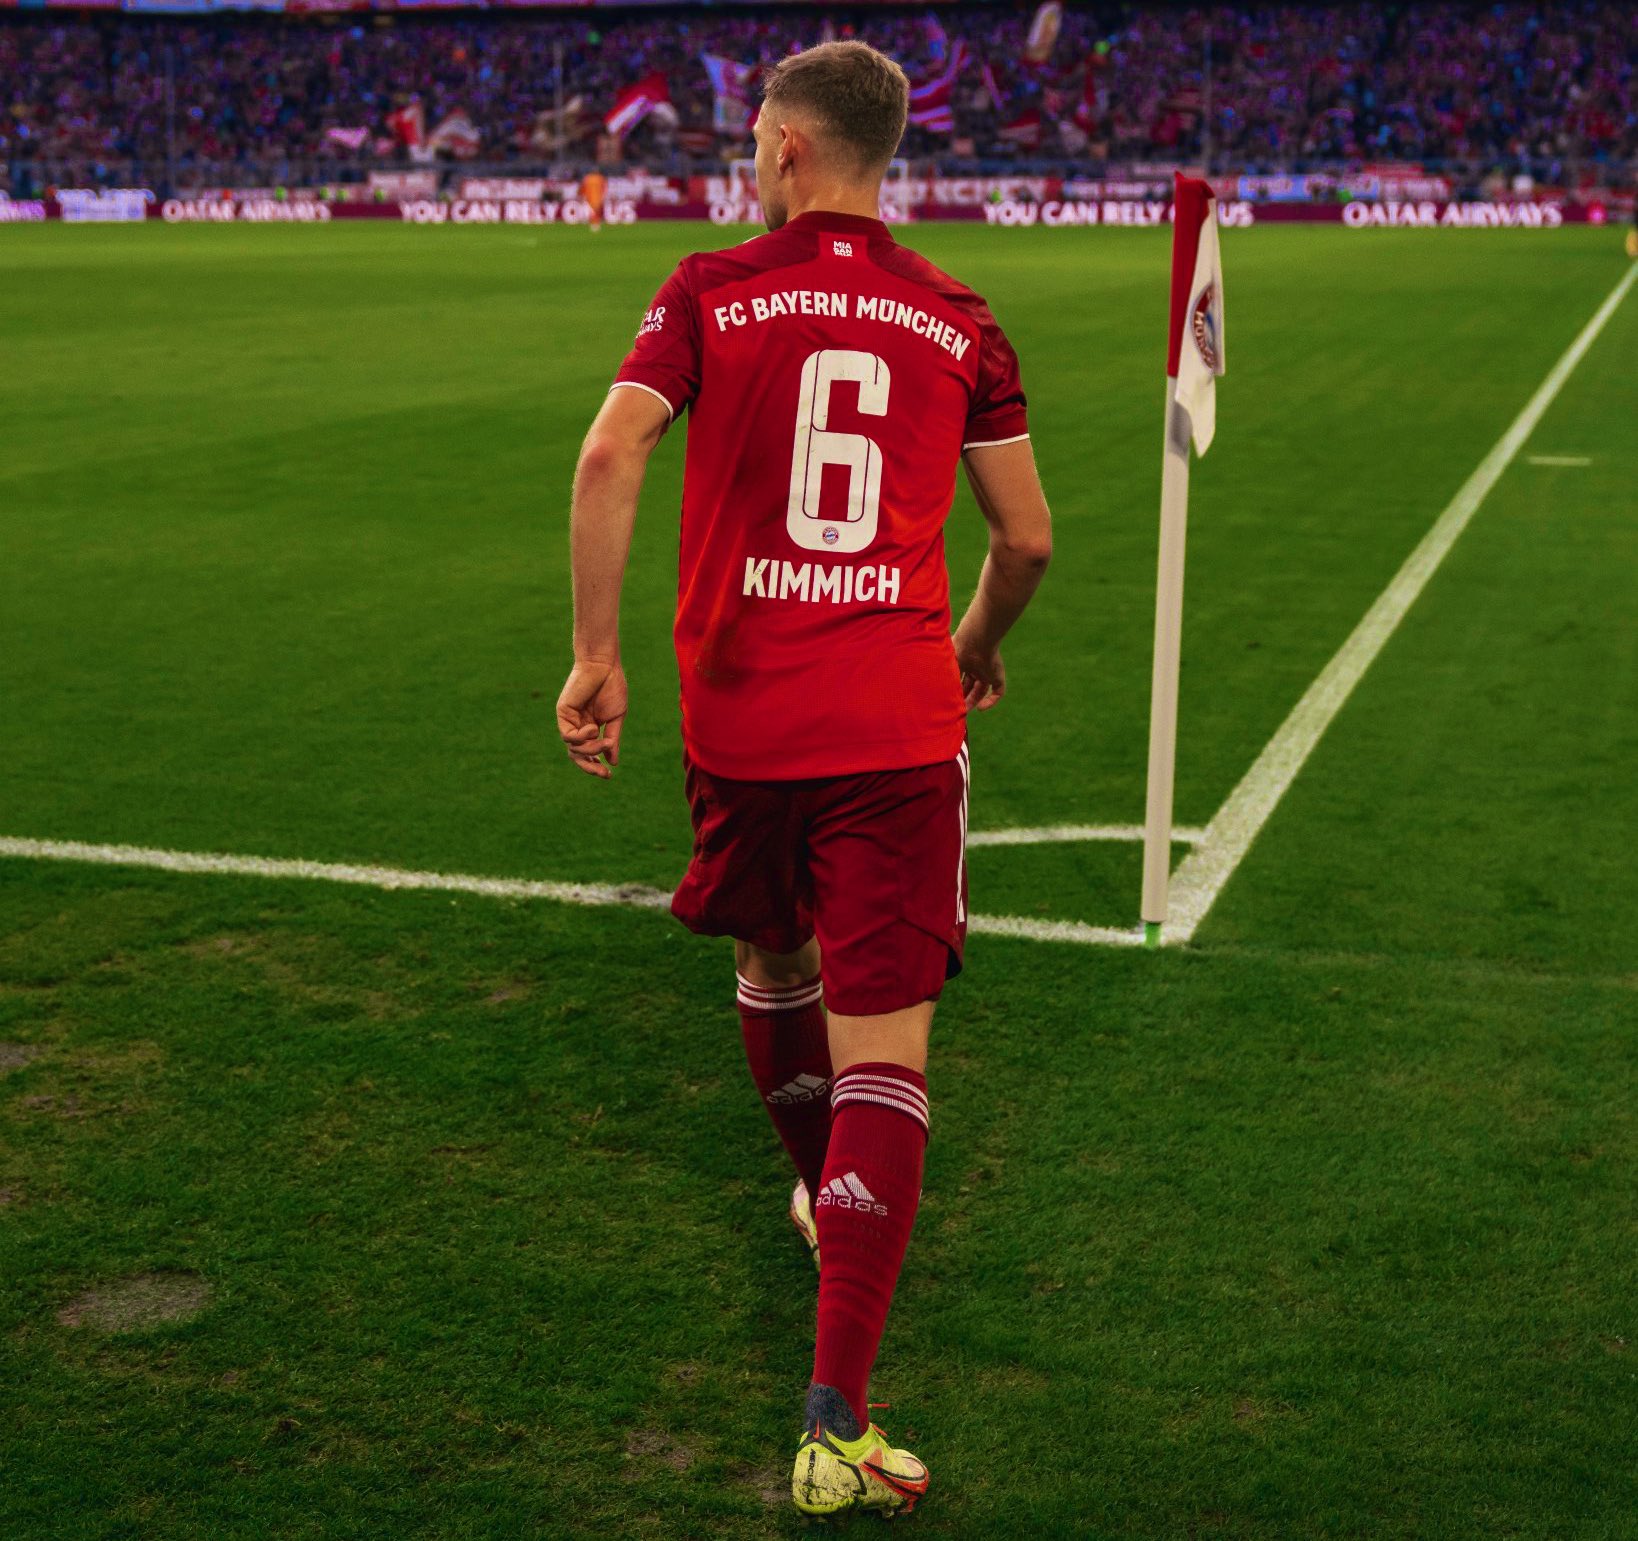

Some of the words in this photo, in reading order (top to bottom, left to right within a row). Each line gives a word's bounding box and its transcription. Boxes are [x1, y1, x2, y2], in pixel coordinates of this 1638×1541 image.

[400, 200, 449, 223] YOU
[451, 200, 500, 223] CAN
[504, 200, 559, 223] RELY
[604, 200, 637, 224] US
[984, 200, 1037, 226] YOU
[1041, 201, 1098, 226] CAN
[1103, 201, 1165, 226] RELY
[1217, 201, 1255, 227] US
[1342, 201, 1437, 227] QATAR
[1440, 201, 1562, 227] AIRWAYS
[714, 301, 748, 332] FC
[751, 290, 848, 323] BAYERN
[856, 295, 970, 362] MÜNCHEN
[785, 349, 891, 554] 6
[742, 556, 901, 605] KIMMICH
[815, 1192, 888, 1217] adidas
